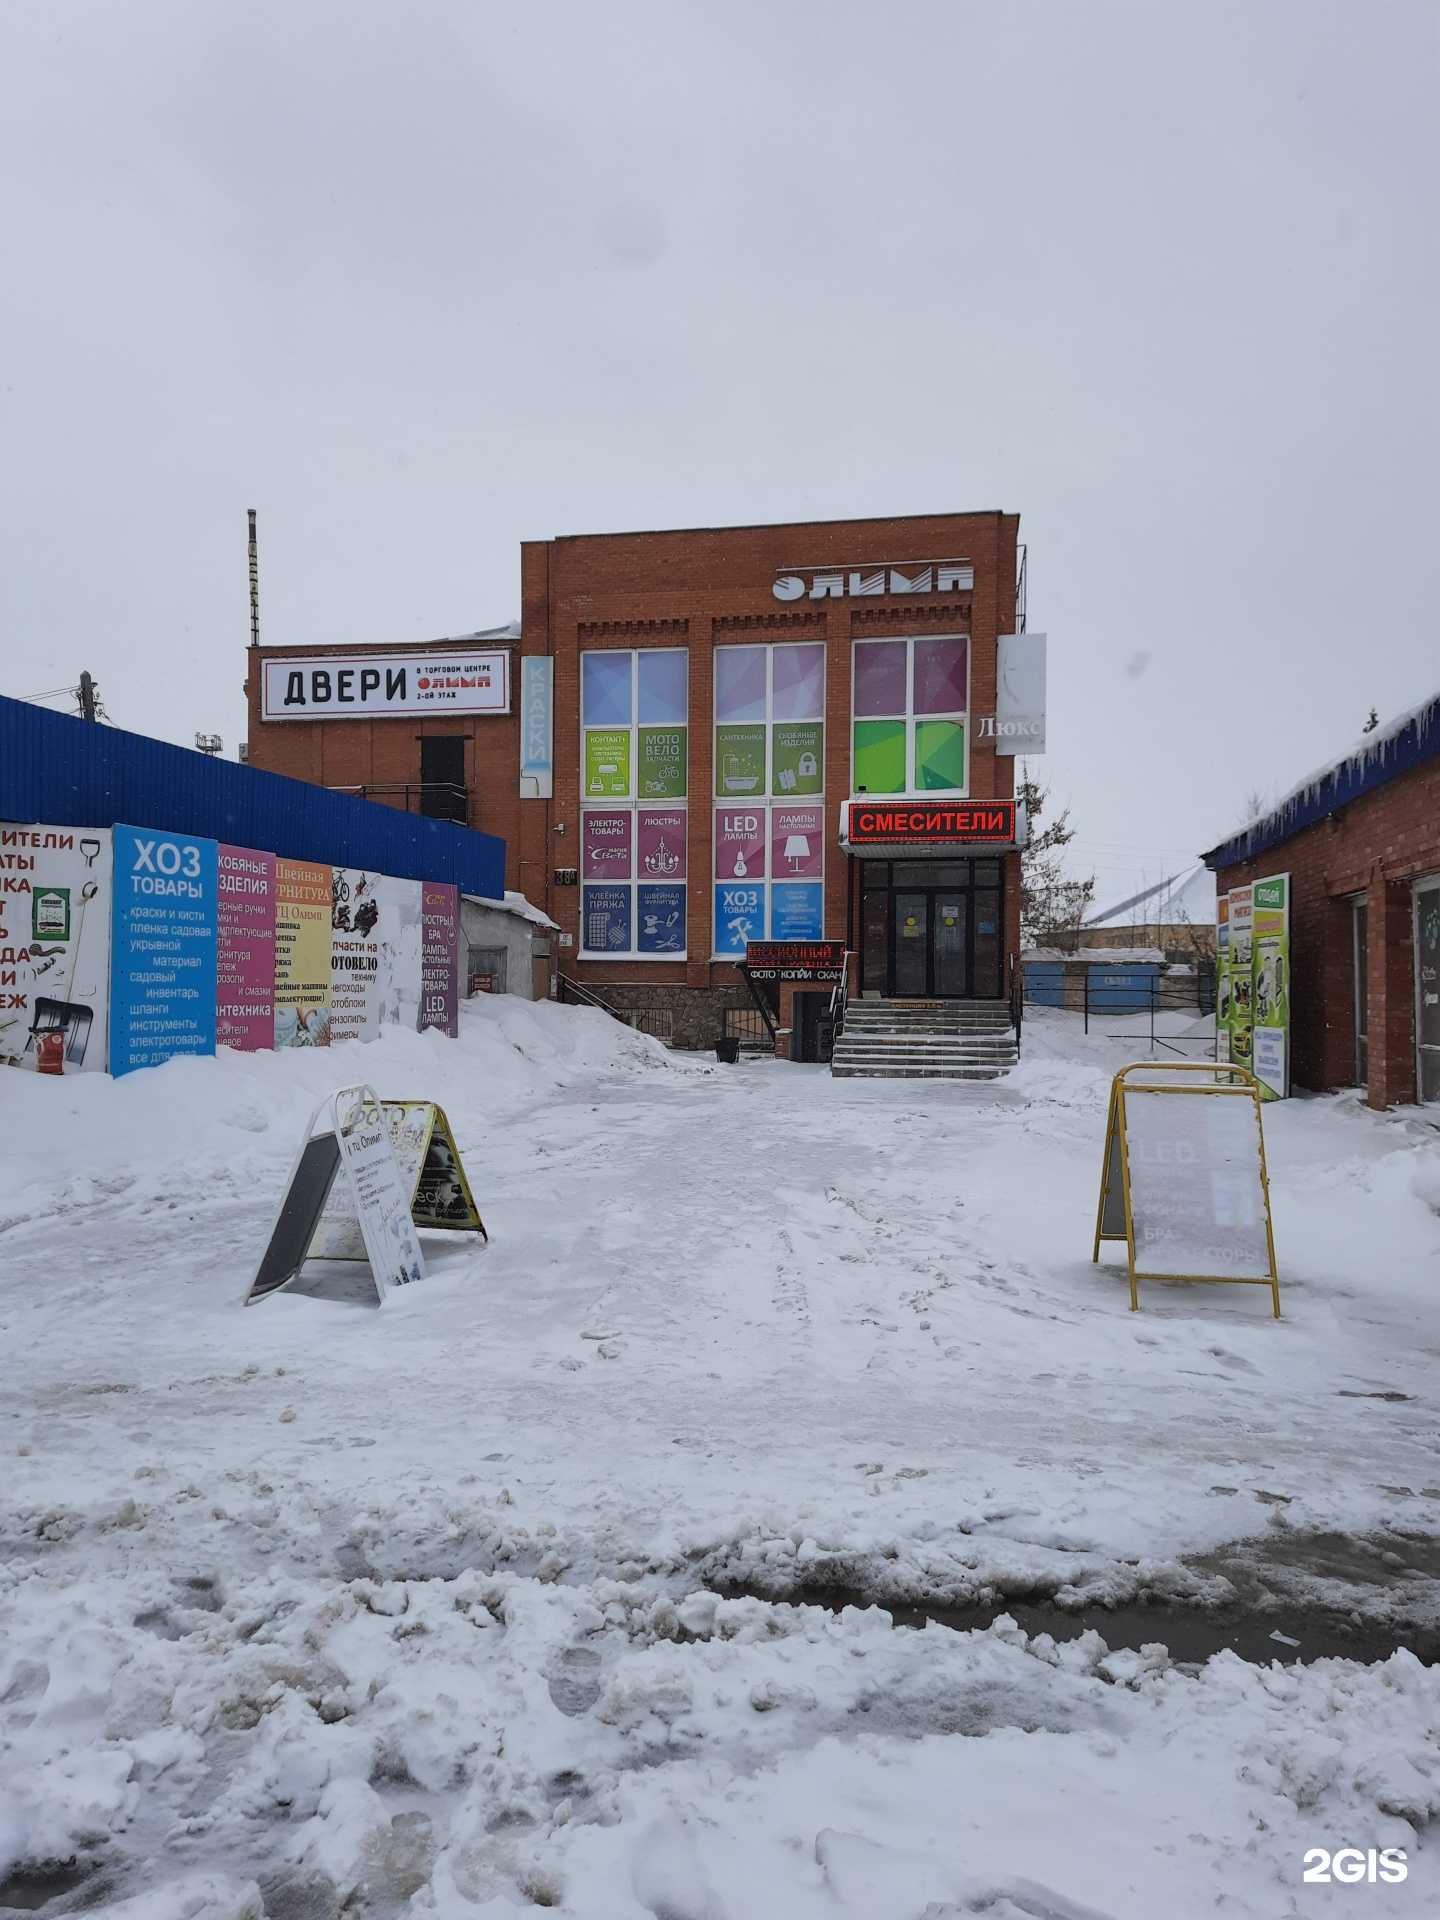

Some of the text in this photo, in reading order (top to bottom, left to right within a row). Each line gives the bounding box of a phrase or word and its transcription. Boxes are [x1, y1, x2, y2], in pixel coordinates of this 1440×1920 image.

[772, 566, 975, 601] ОЛИМП
[425, 666, 461, 674] ТОРГОВОМ
[464, 664, 492, 673] ЦЕНТРЕ
[284, 668, 407, 706] ДВЕРИ
[417, 676, 491, 690] ОЛИМП
[438, 691, 457, 699] ЭТАЖ
[528, 666, 546, 761] КРАСКИ
[645, 734, 680, 745] МОТО
[645, 745, 680, 755] ВЕЛО
[588, 819, 627, 828] ЭЛЕКТРО-
[643, 817, 681, 826] ЛЮСТРЫ
[724, 815, 758, 832] LED
[779, 814, 816, 824] ЛАМПЫ
[860, 811, 1004, 832] СМЕСИТЕЛИ
[590, 828, 624, 836] ТОВАРЫ
[723, 831, 758, 841] ЛАМПЫ
[2, 830, 74, 850] ИТЕЛИ
[132, 838, 202, 878] ХОЗ
[0, 877, 31, 893] КА
[131, 875, 203, 899] ТОВАРЫ
[219, 875, 268, 895] ЗДЕЛИЯ
[276, 883, 330, 901] РНИТУРА
[723, 891, 758, 906] ХОЗ
[245, 904, 266, 916] ручки
[589, 900, 625, 910] ПРЯЖА
[723, 906, 758, 914] ТОВАРЫ
[129, 907, 205, 921] краски и кисти
[130, 922, 212, 937] пленка садовая
[428, 929, 441, 940] БРА
[130, 939, 181, 951] укрывной
[367, 943, 378, 953] на
[152, 957, 202, 969] материал
[331, 955, 378, 971] ОТОВЕЛО
[129, 970, 176, 983] садовый
[351, 973, 377, 984] технику
[750, 970, 776, 979] ФОТО
[146, 987, 199, 1001] инвентарь
[245, 987, 271, 997] смазки
[129, 1003, 169, 1015] шланги
[426, 996, 445, 1012] LED
[422, 1013, 449, 1024] ЛАМПЫ
[129, 1018, 198, 1034] инструменты
[129, 1034, 207, 1048] электротовары
[129, 1053, 149, 1065] все
